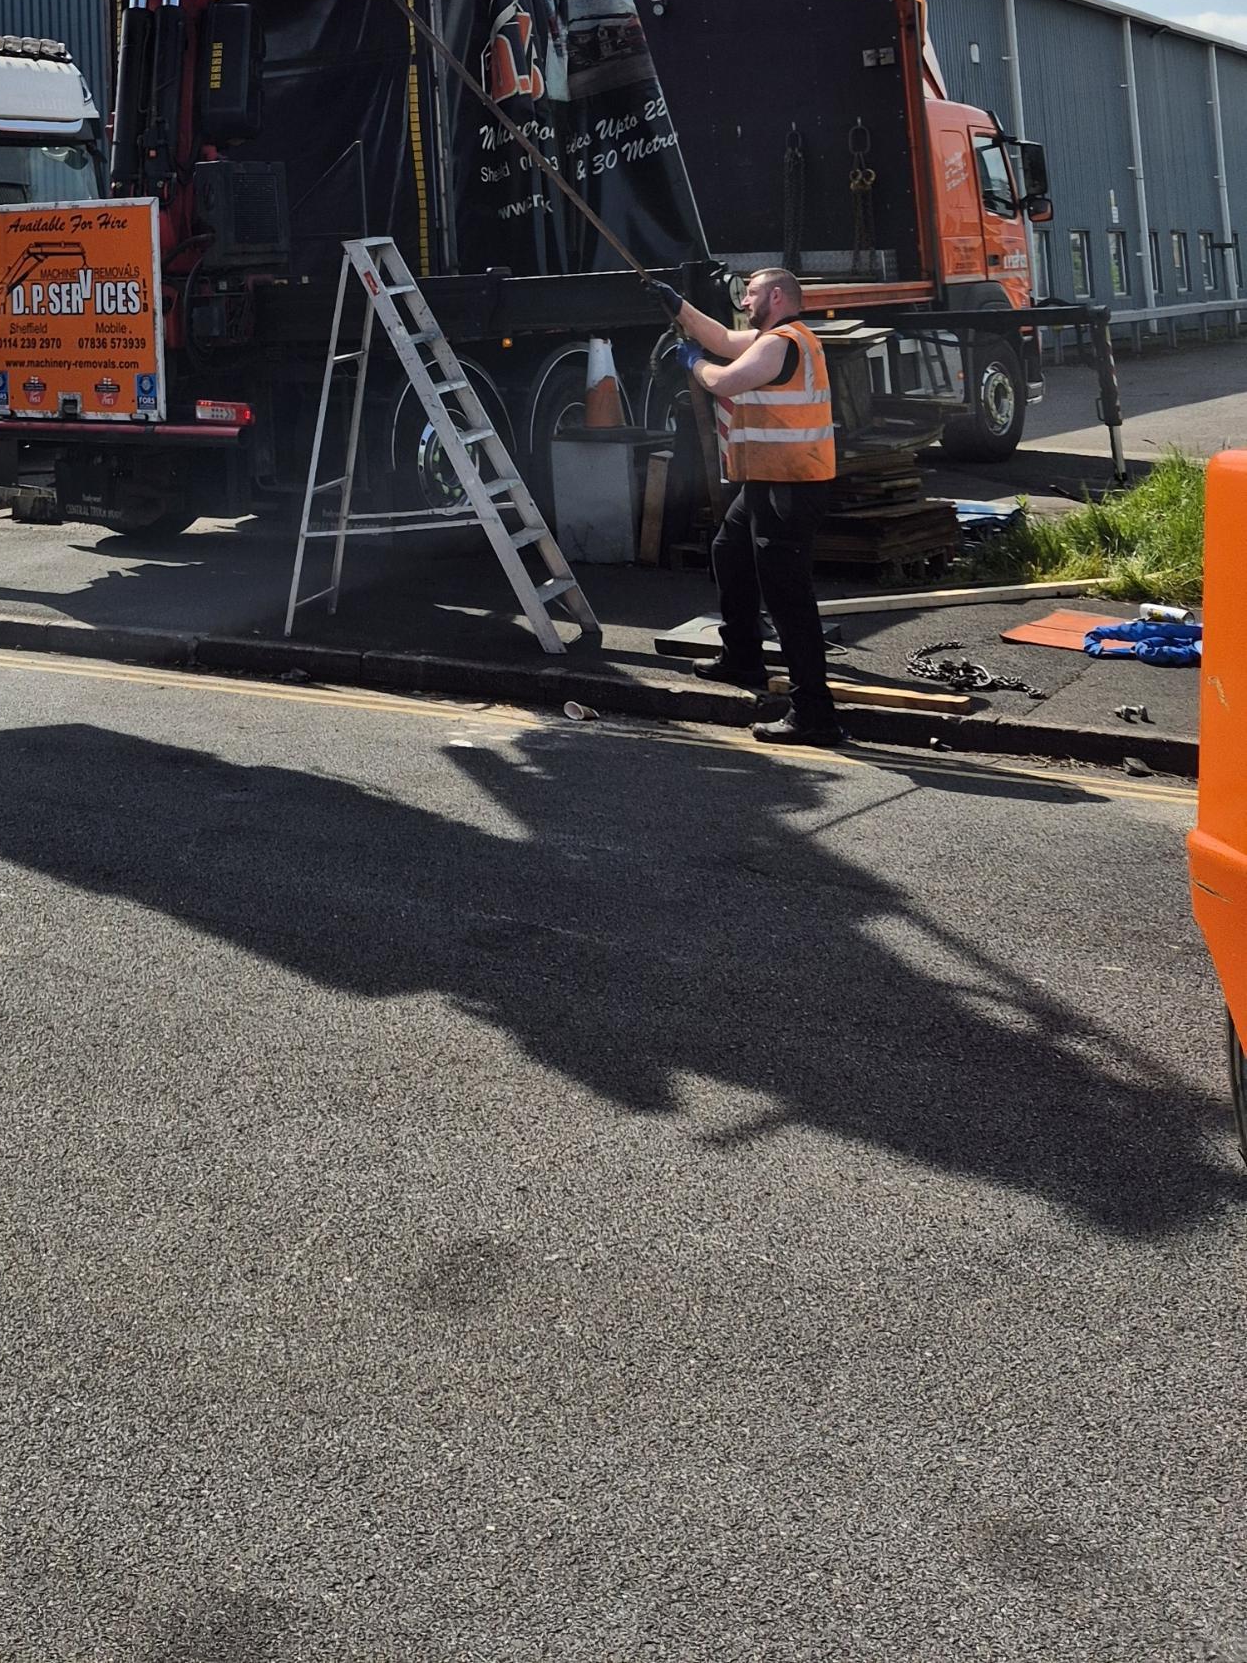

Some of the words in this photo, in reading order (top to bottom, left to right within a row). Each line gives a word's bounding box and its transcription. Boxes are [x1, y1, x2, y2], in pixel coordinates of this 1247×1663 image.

[595, 114, 639, 141] Upto
[577, 153, 587, 181] &
[592, 149, 618, 176] 30
[6, 217, 65, 234] Available
[69, 214, 93, 234] For
[97, 212, 128, 231] Hire
[94, 265, 140, 279] REMOVALS
[9, 321, 48, 335] Sheffield
[20, 337, 37, 350] 239
[39, 337, 62, 350] 2970
[78, 337, 108, 350] 07836
[111, 337, 146, 350] 573939
[5, 358, 139, 371] www.machinery-removals.com
